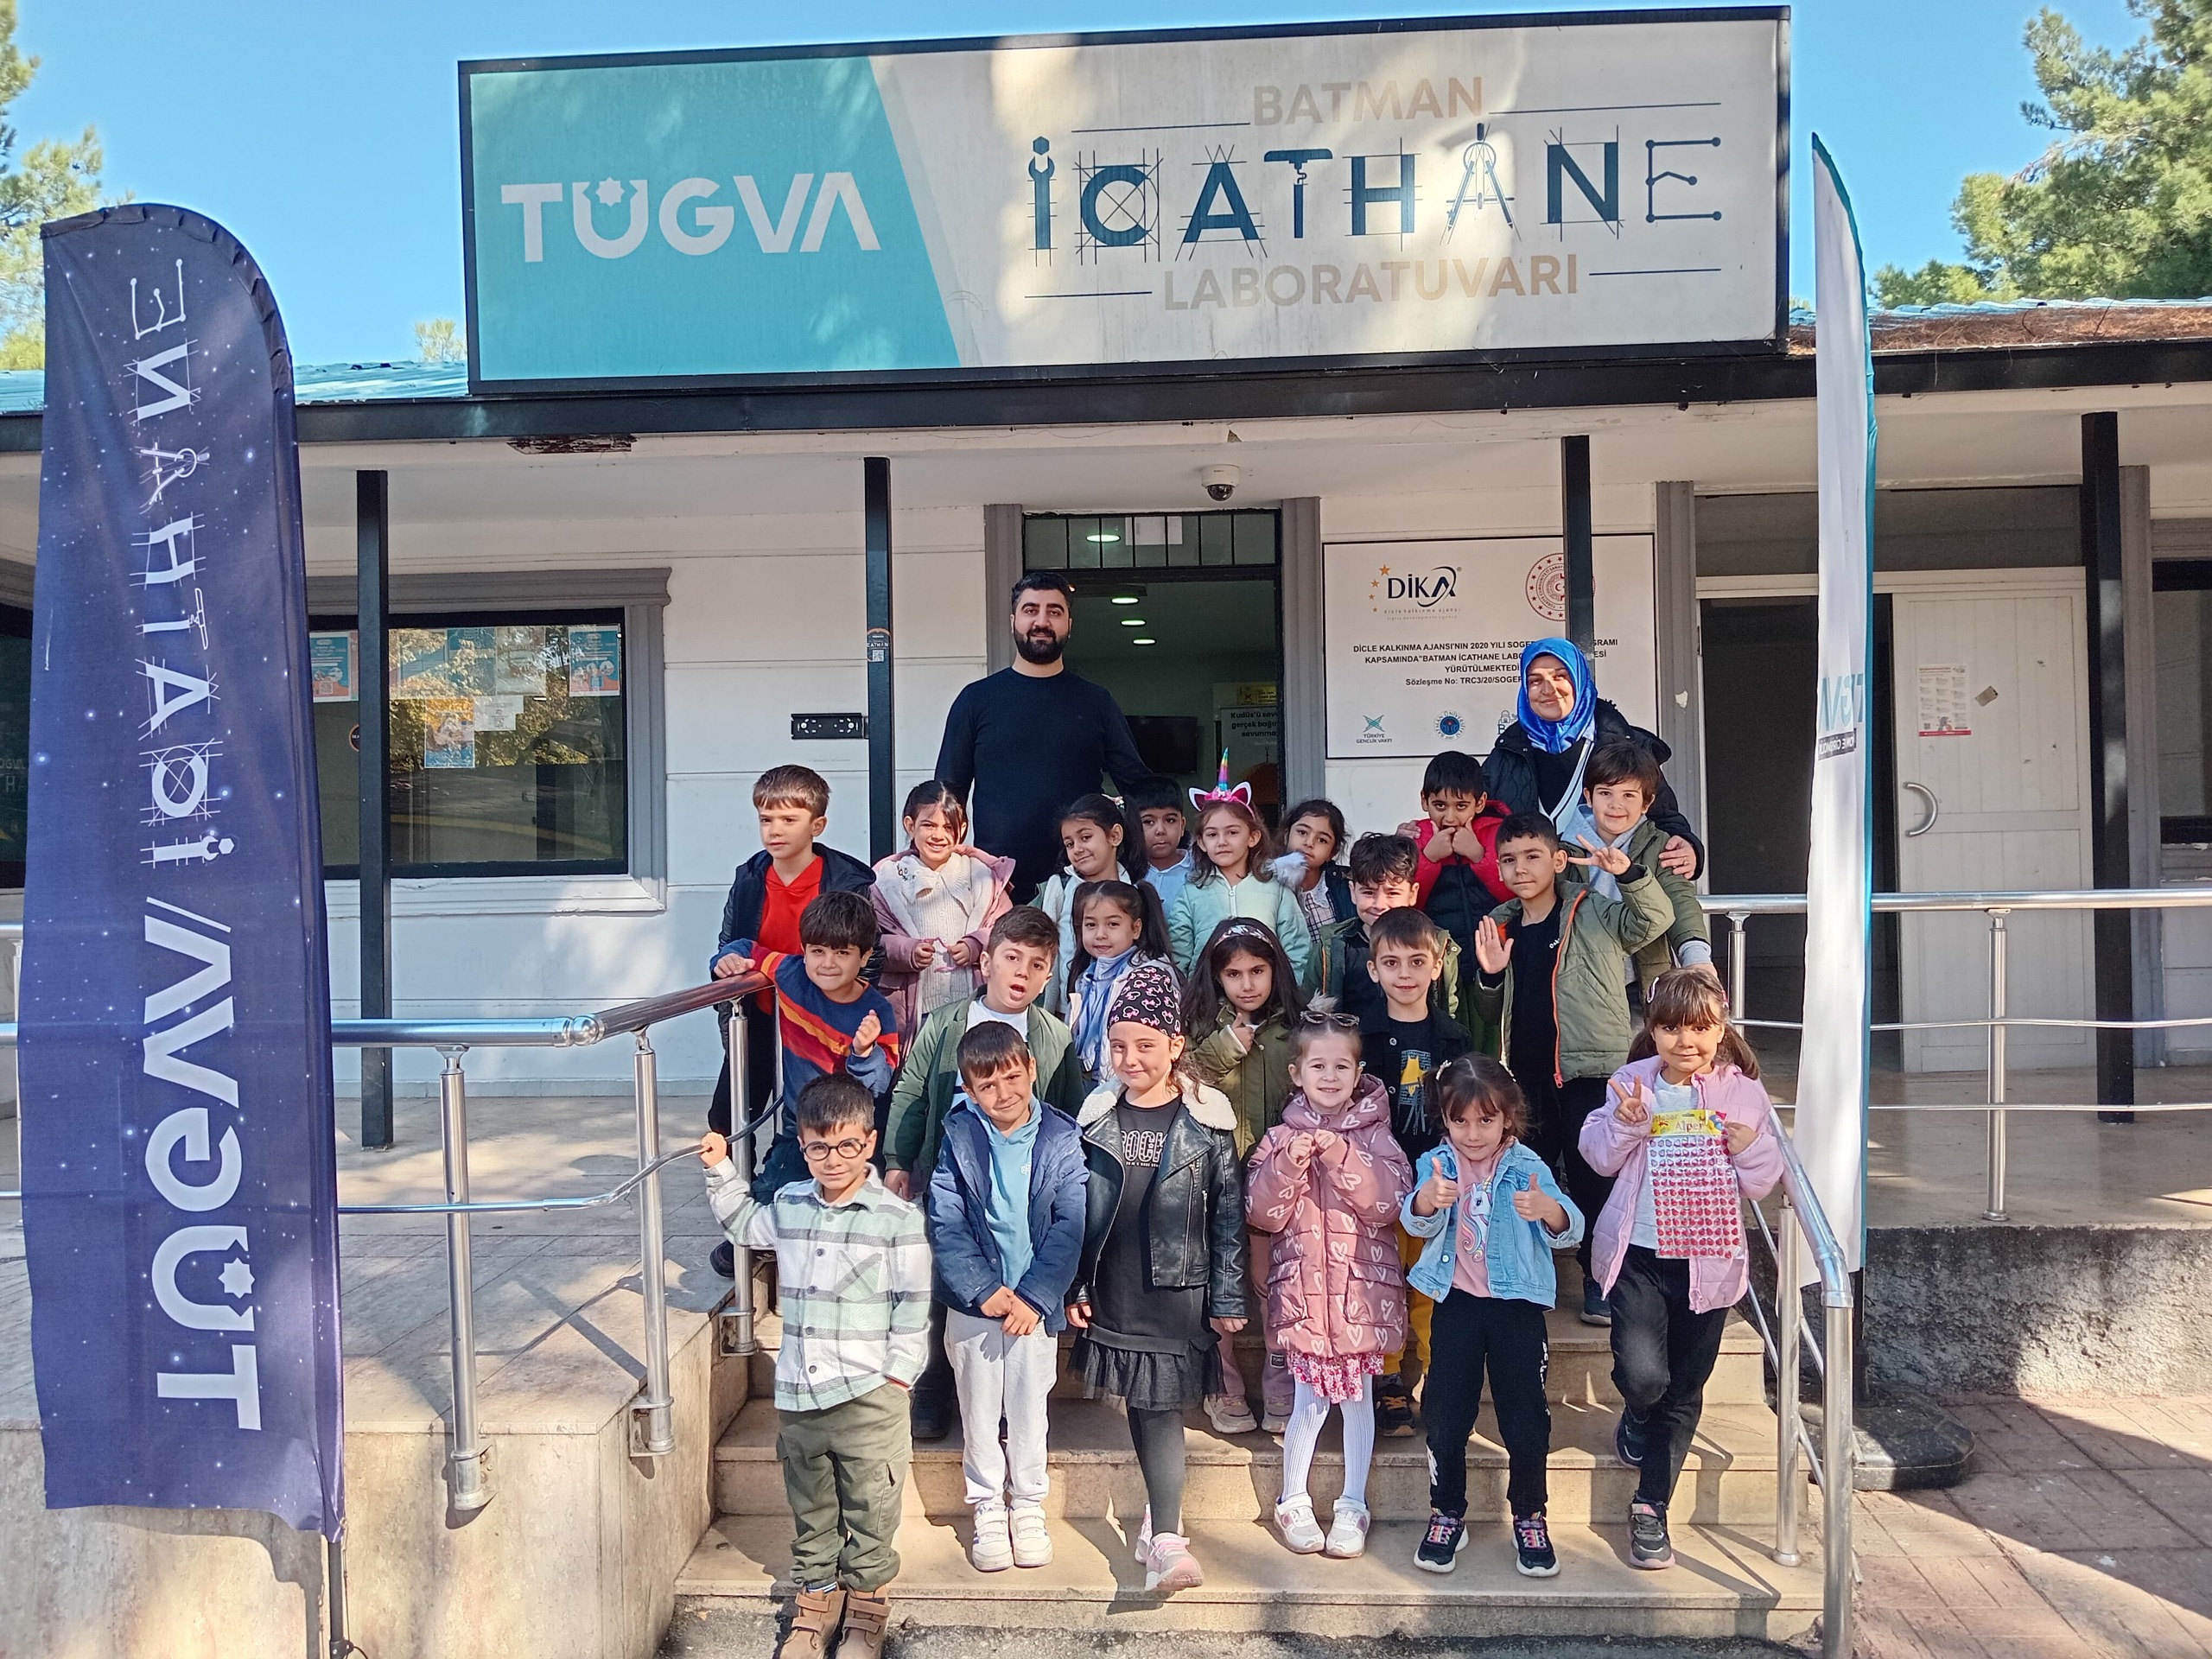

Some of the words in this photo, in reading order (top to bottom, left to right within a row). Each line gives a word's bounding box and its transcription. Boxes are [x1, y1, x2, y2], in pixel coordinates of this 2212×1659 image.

[1253, 75, 1484, 126] BATMAN
[1027, 123, 1722, 266] İCATHANE
[500, 171, 881, 264] TÜGVA
[1162, 254, 1580, 312] LABORATUVARI
[1387, 569, 1458, 604] DİKA
[1353, 644, 1377, 652] DİCLE
[1379, 644, 1422, 652] KALKINMA
[1458, 652, 1501, 661] İCATHANE
[1444, 664, 1520, 673] YÜRÜTÜLMEKTEDİ
[1405, 677, 1443, 687] Sözleşme
[1675, 1119, 1704, 1133] Alper
